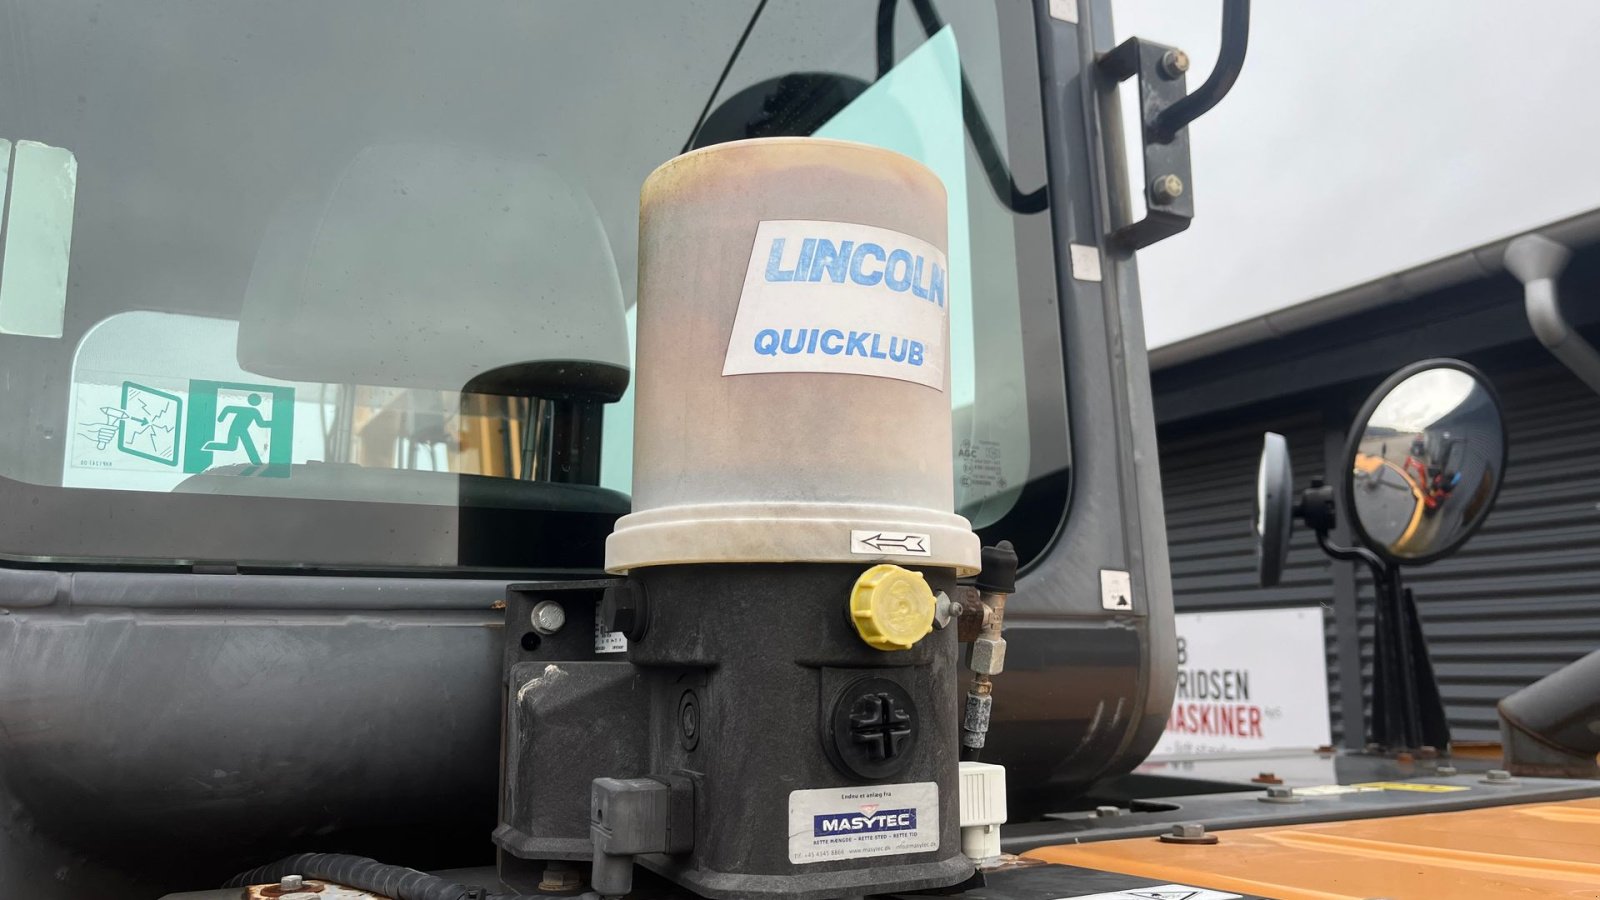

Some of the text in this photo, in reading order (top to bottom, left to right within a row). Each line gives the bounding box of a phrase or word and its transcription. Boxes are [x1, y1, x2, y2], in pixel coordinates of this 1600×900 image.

[764, 237, 945, 308] LINCOLN
[753, 328, 925, 367] QUICKLUB
[822, 813, 910, 831] MASYTEC
